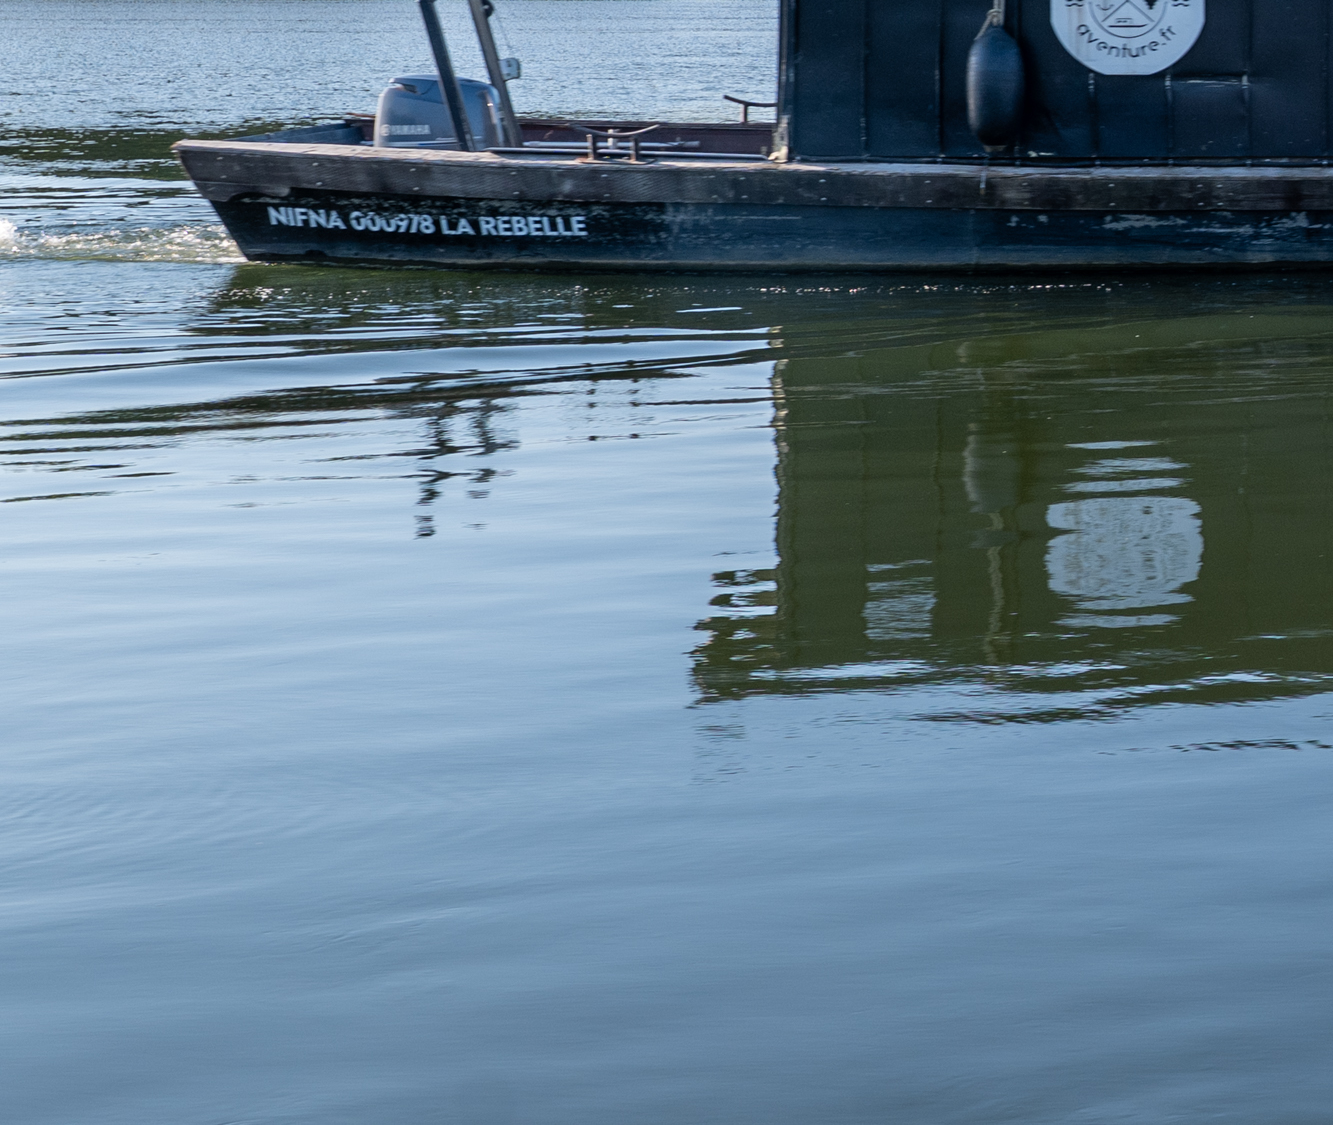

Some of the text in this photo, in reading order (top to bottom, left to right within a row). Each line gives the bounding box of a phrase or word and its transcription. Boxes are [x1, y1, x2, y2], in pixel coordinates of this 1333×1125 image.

[1076, 24, 1177, 58] aventure.fr
[267, 206, 347, 229] NIFNA
[439, 215, 476, 235] LA
[478, 216, 589, 236] REBELLE
